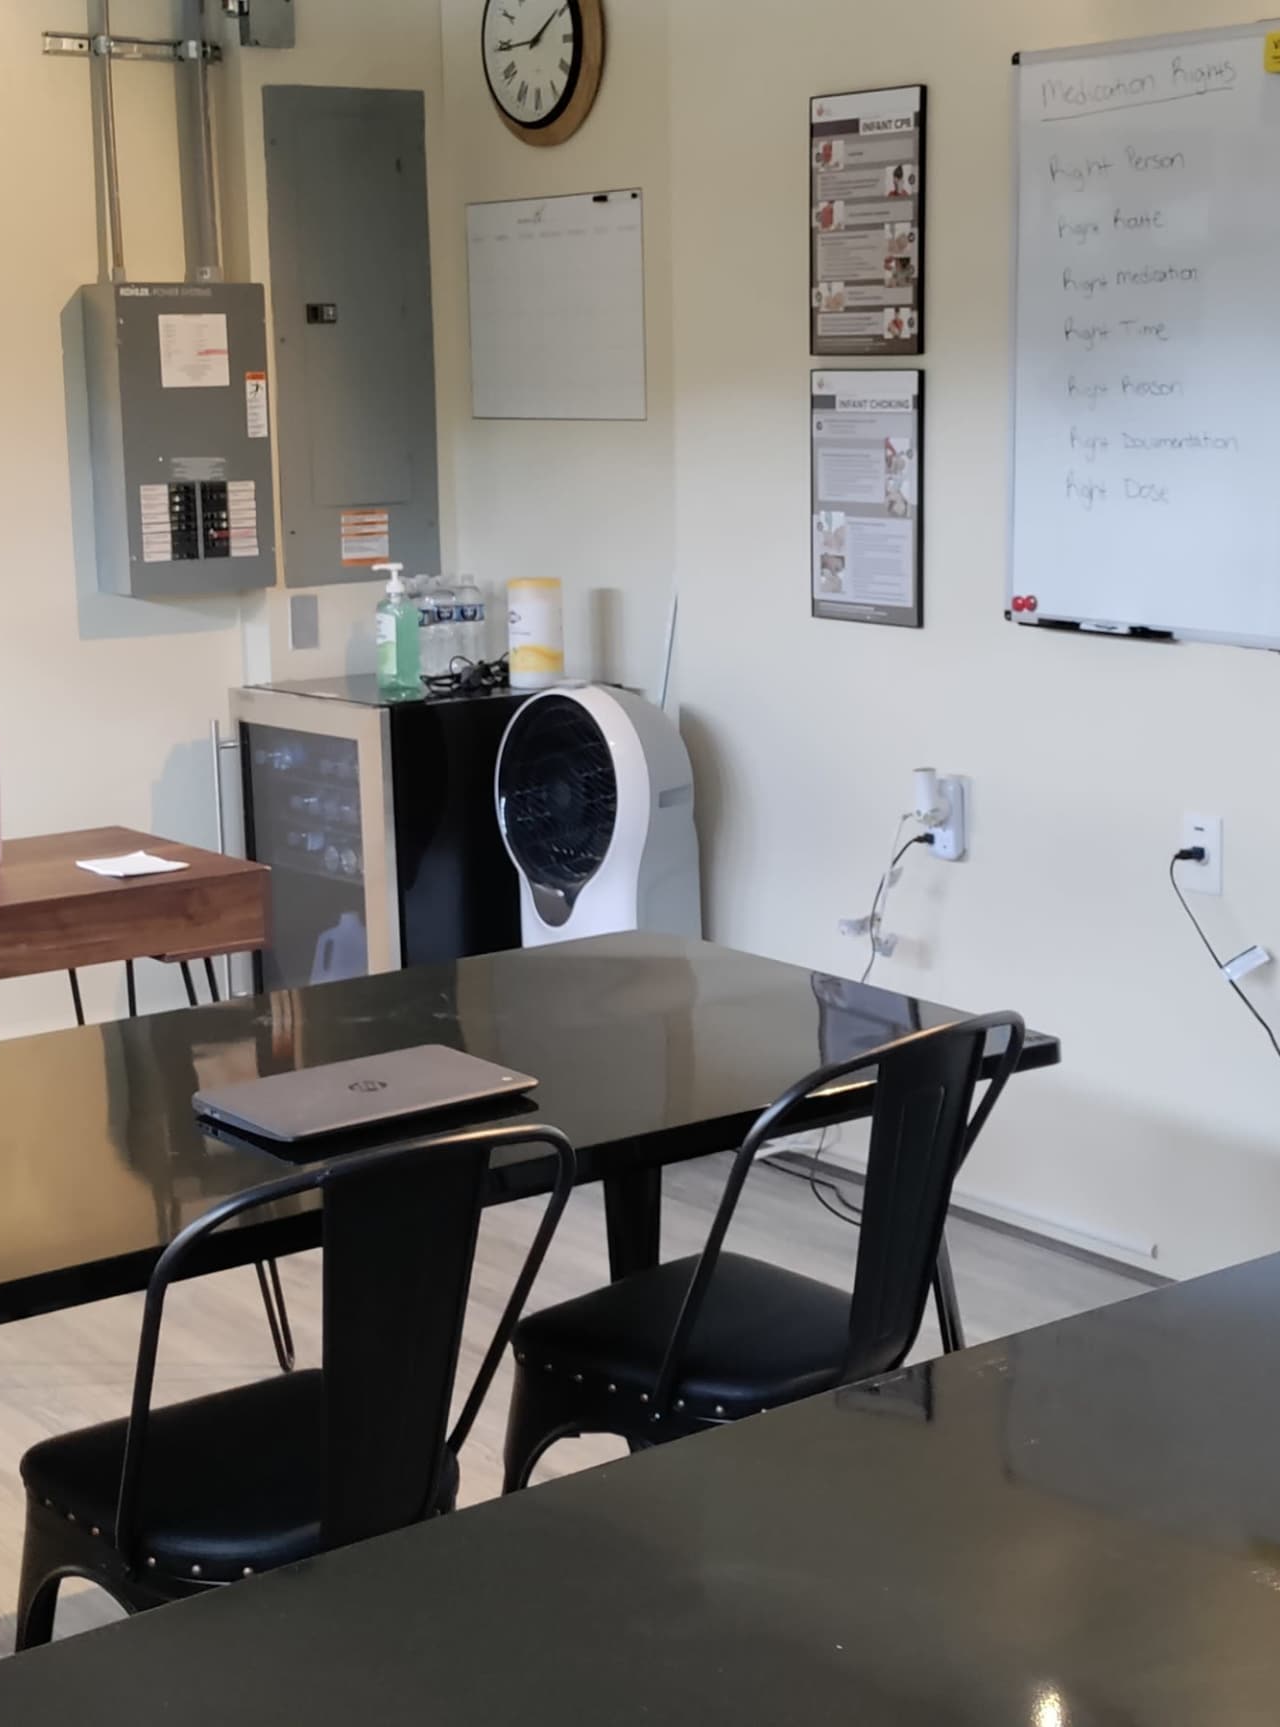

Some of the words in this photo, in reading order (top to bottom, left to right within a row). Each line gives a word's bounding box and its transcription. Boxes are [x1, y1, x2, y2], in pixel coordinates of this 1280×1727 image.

[1041, 72, 1155, 108] Medication
[1125, 146, 1185, 171] Person
[1119, 318, 1169, 342] Time
